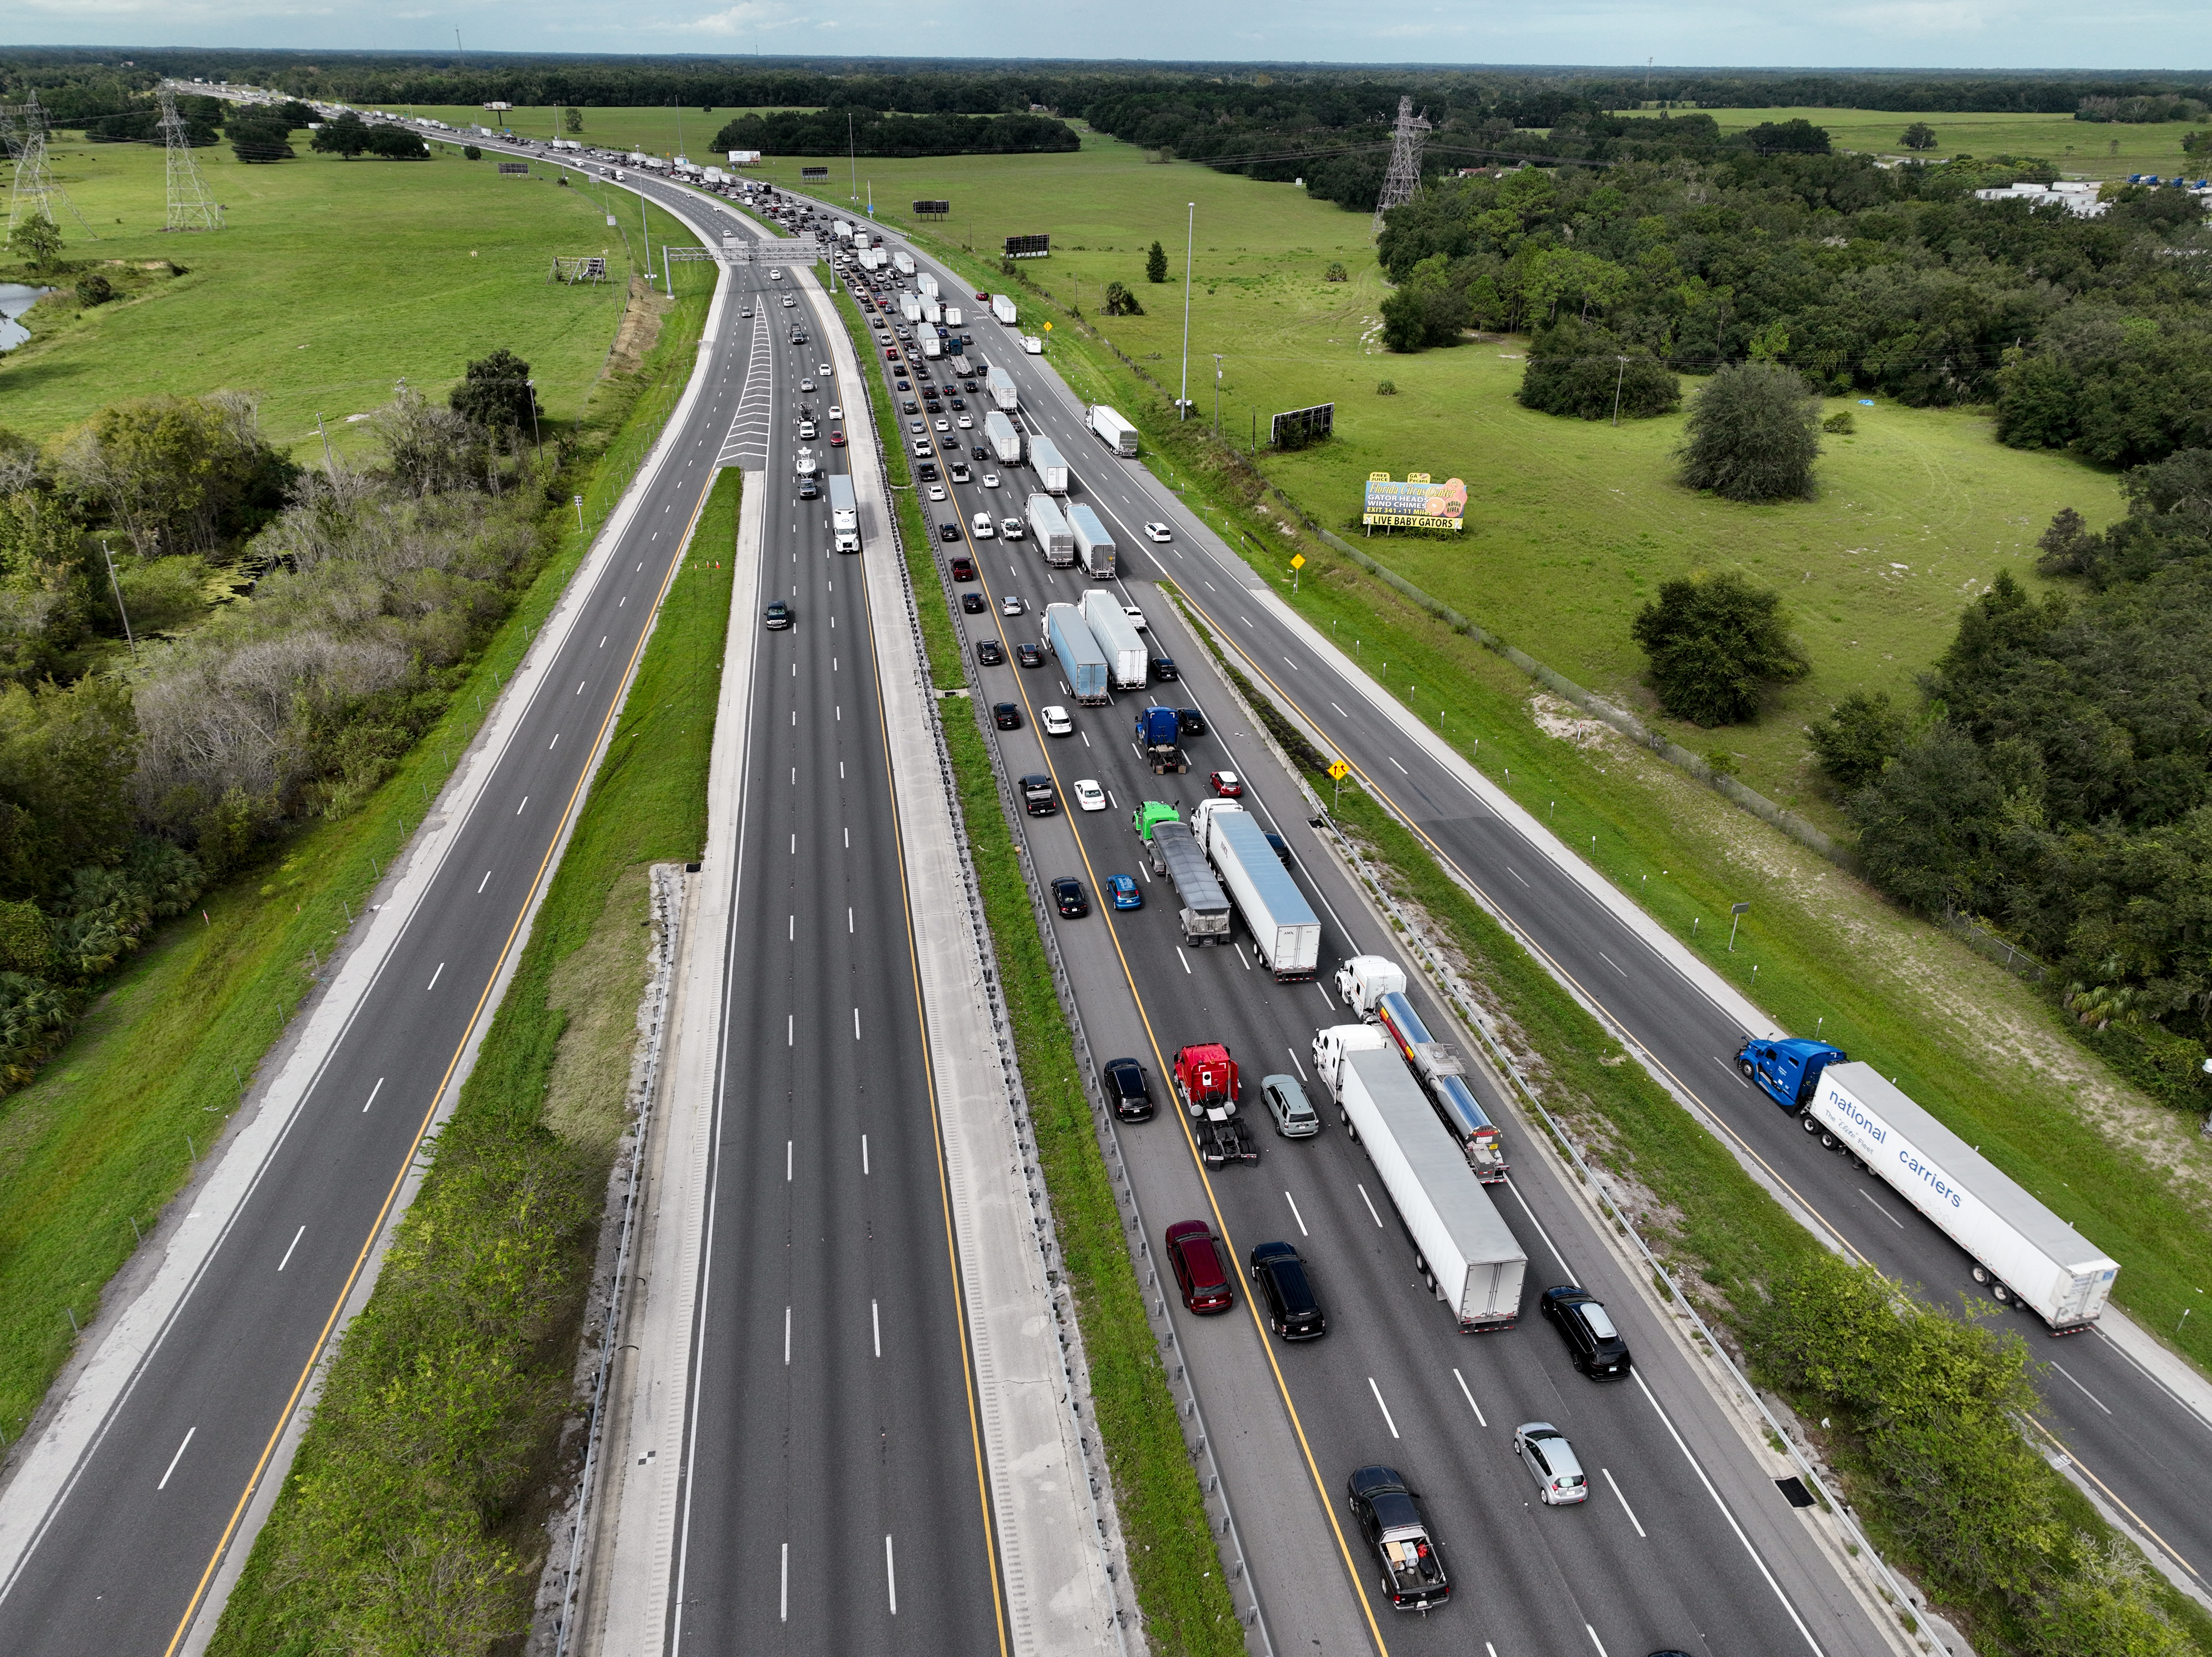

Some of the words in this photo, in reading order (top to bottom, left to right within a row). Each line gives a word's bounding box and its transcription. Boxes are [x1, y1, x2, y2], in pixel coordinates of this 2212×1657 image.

[1369, 483, 1399, 494] Florida
[1401, 484, 1426, 496] Citrus
[1428, 485, 1456, 498] Center
[1373, 516, 1392, 525] LIVE
[1394, 516, 1417, 526] BABY
[1419, 518, 1453, 528] GATORS
[1826, 1109, 1836, 1123] The
[1858, 1138, 1873, 1155] Fleet
[1830, 1090, 1886, 1144] national
[1899, 1150, 1961, 1208] carriers
